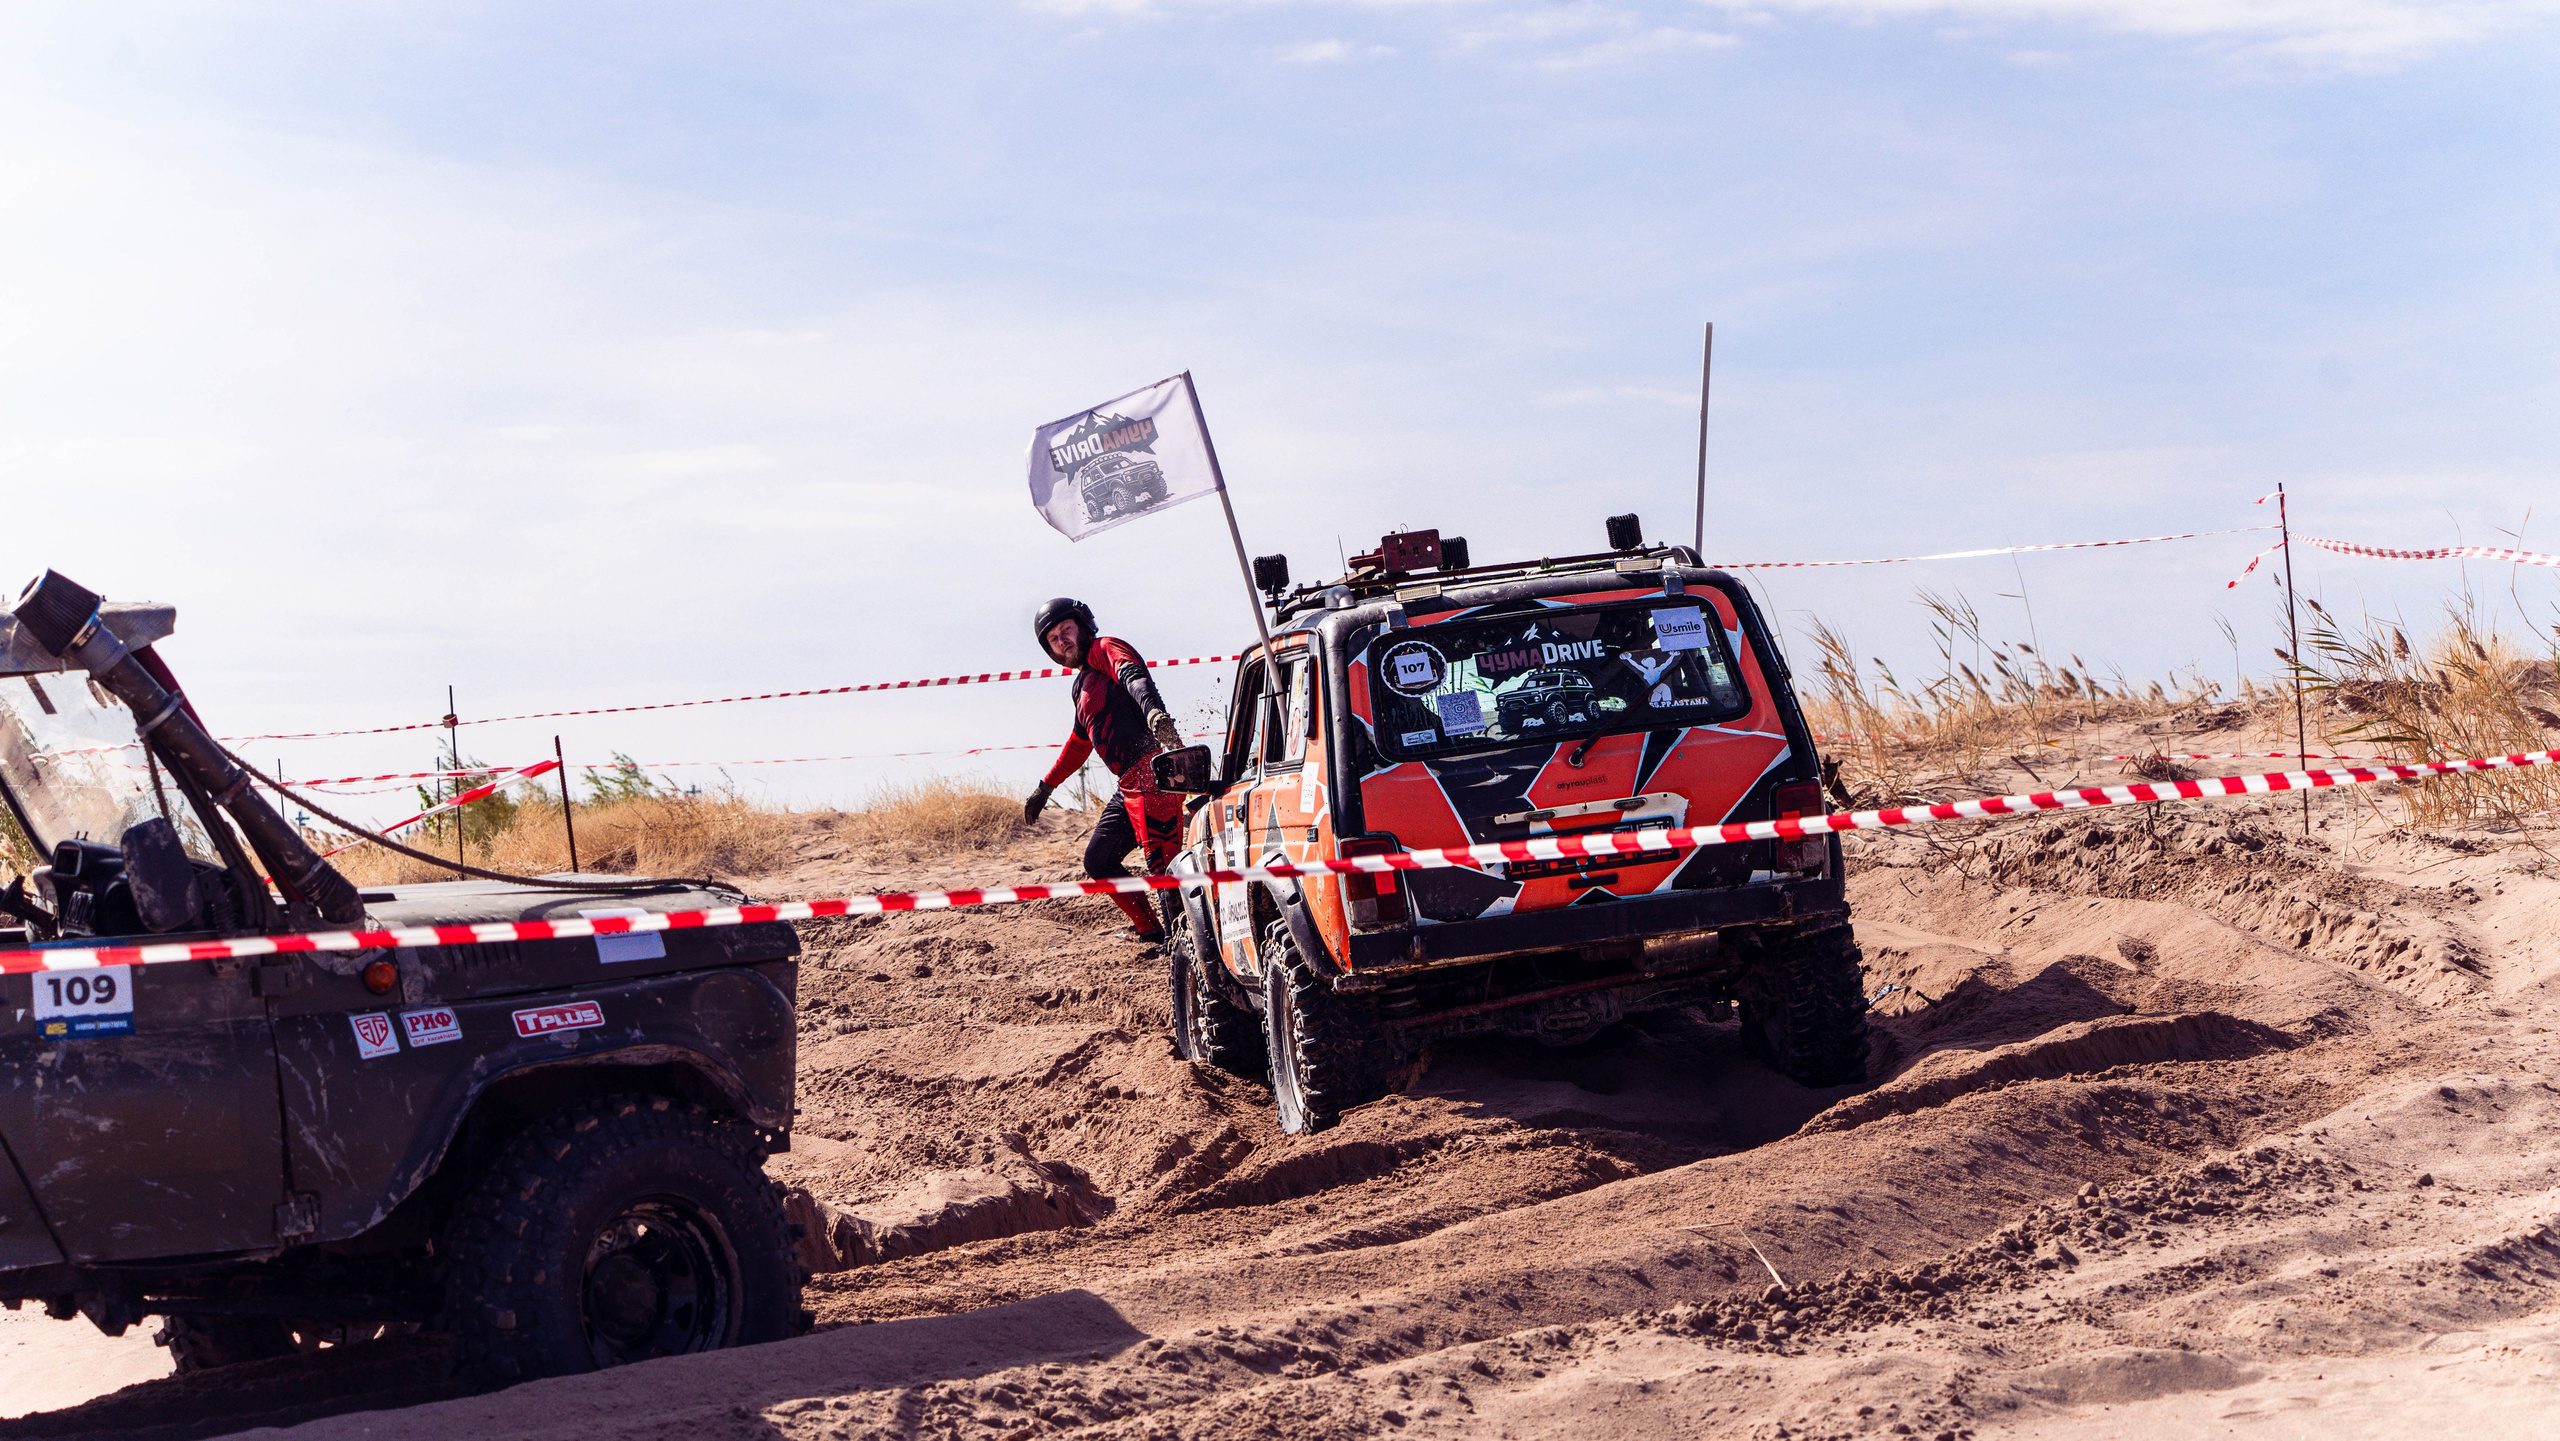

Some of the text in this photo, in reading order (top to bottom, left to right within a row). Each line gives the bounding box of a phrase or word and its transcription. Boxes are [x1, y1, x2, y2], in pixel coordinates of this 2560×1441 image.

[1401, 661, 1425, 674] 107
[1556, 774, 1607, 790] atyrauplast
[47, 974, 116, 1007] 109
[406, 1011, 452, 1033] РИФ
[519, 1009, 599, 1031] TPLUS
